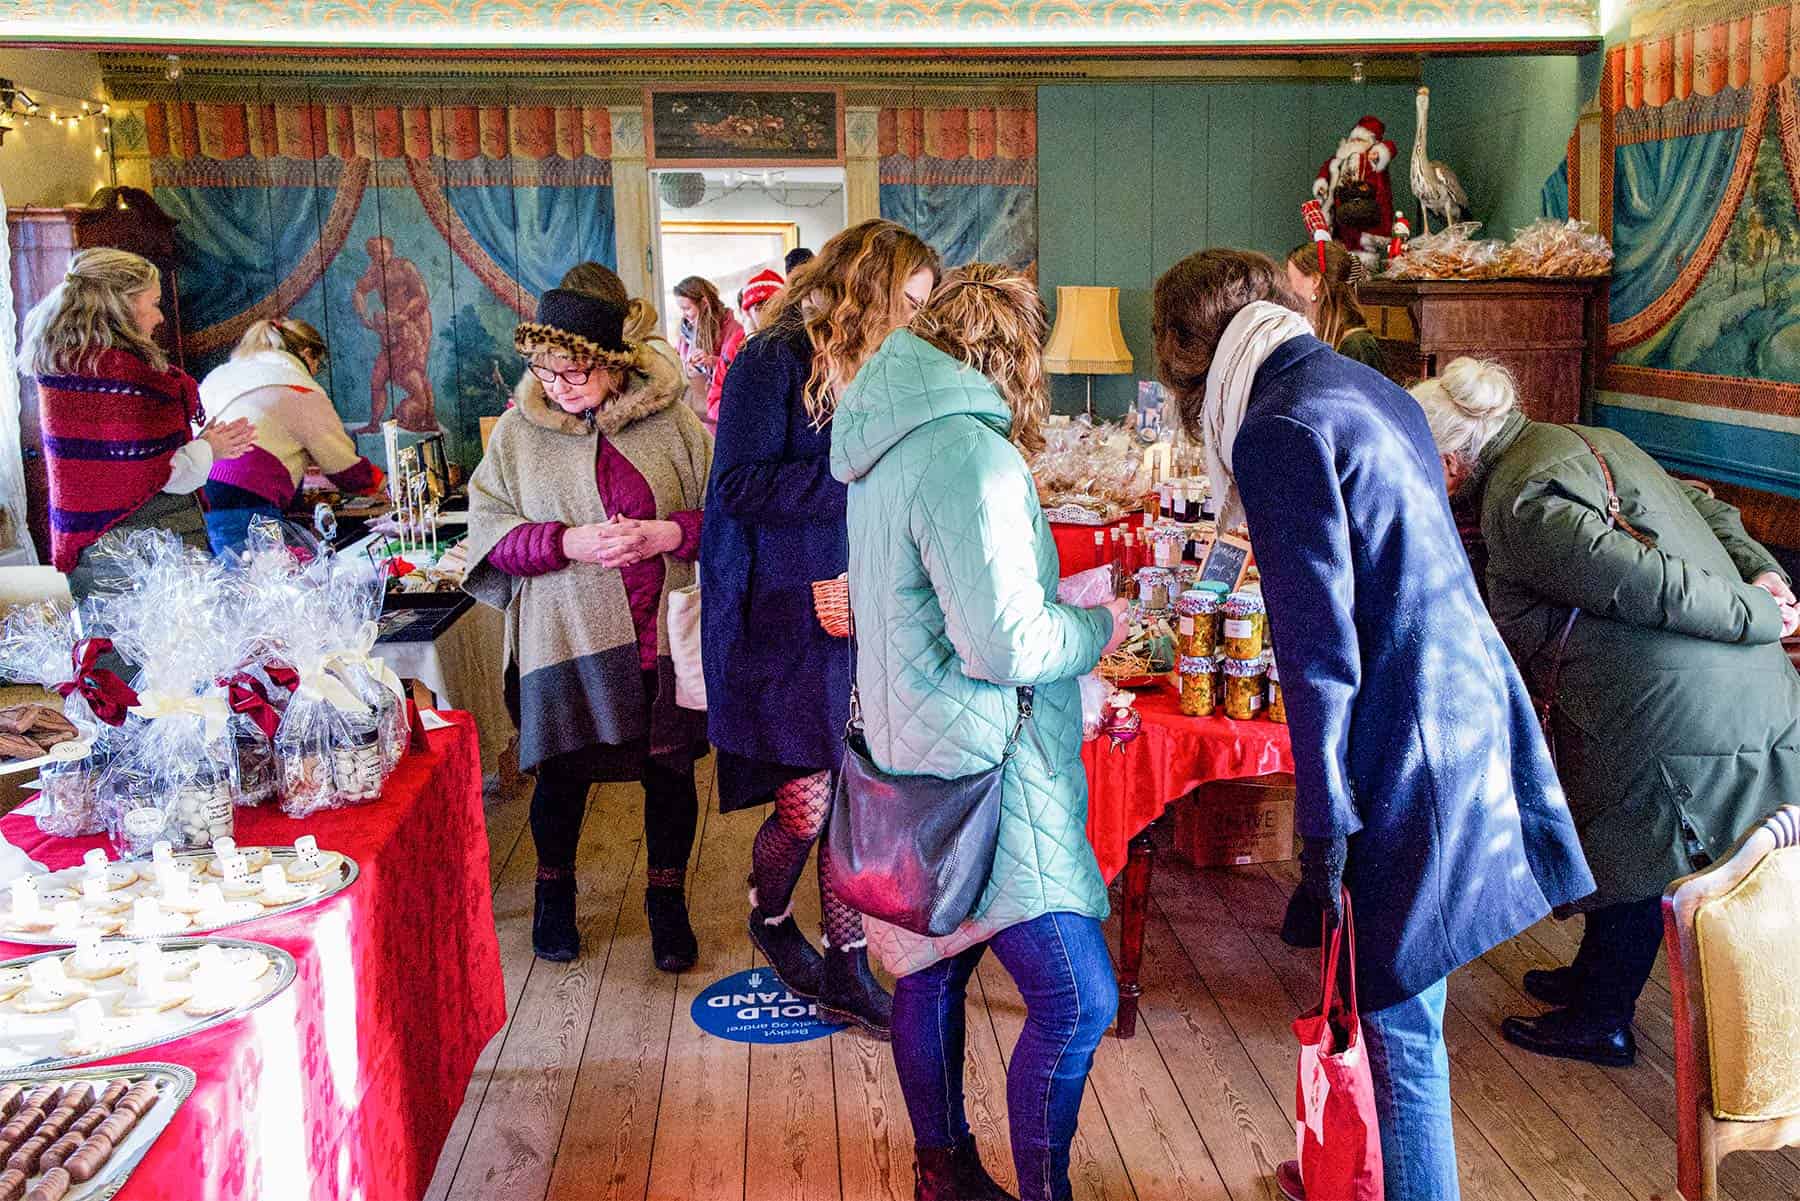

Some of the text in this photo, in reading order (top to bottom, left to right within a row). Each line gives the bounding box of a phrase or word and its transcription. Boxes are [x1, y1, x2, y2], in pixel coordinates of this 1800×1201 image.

[707, 991, 800, 1007] TAND
[726, 1023, 768, 1033] andre!
[764, 1028, 809, 1037] Beskyt
